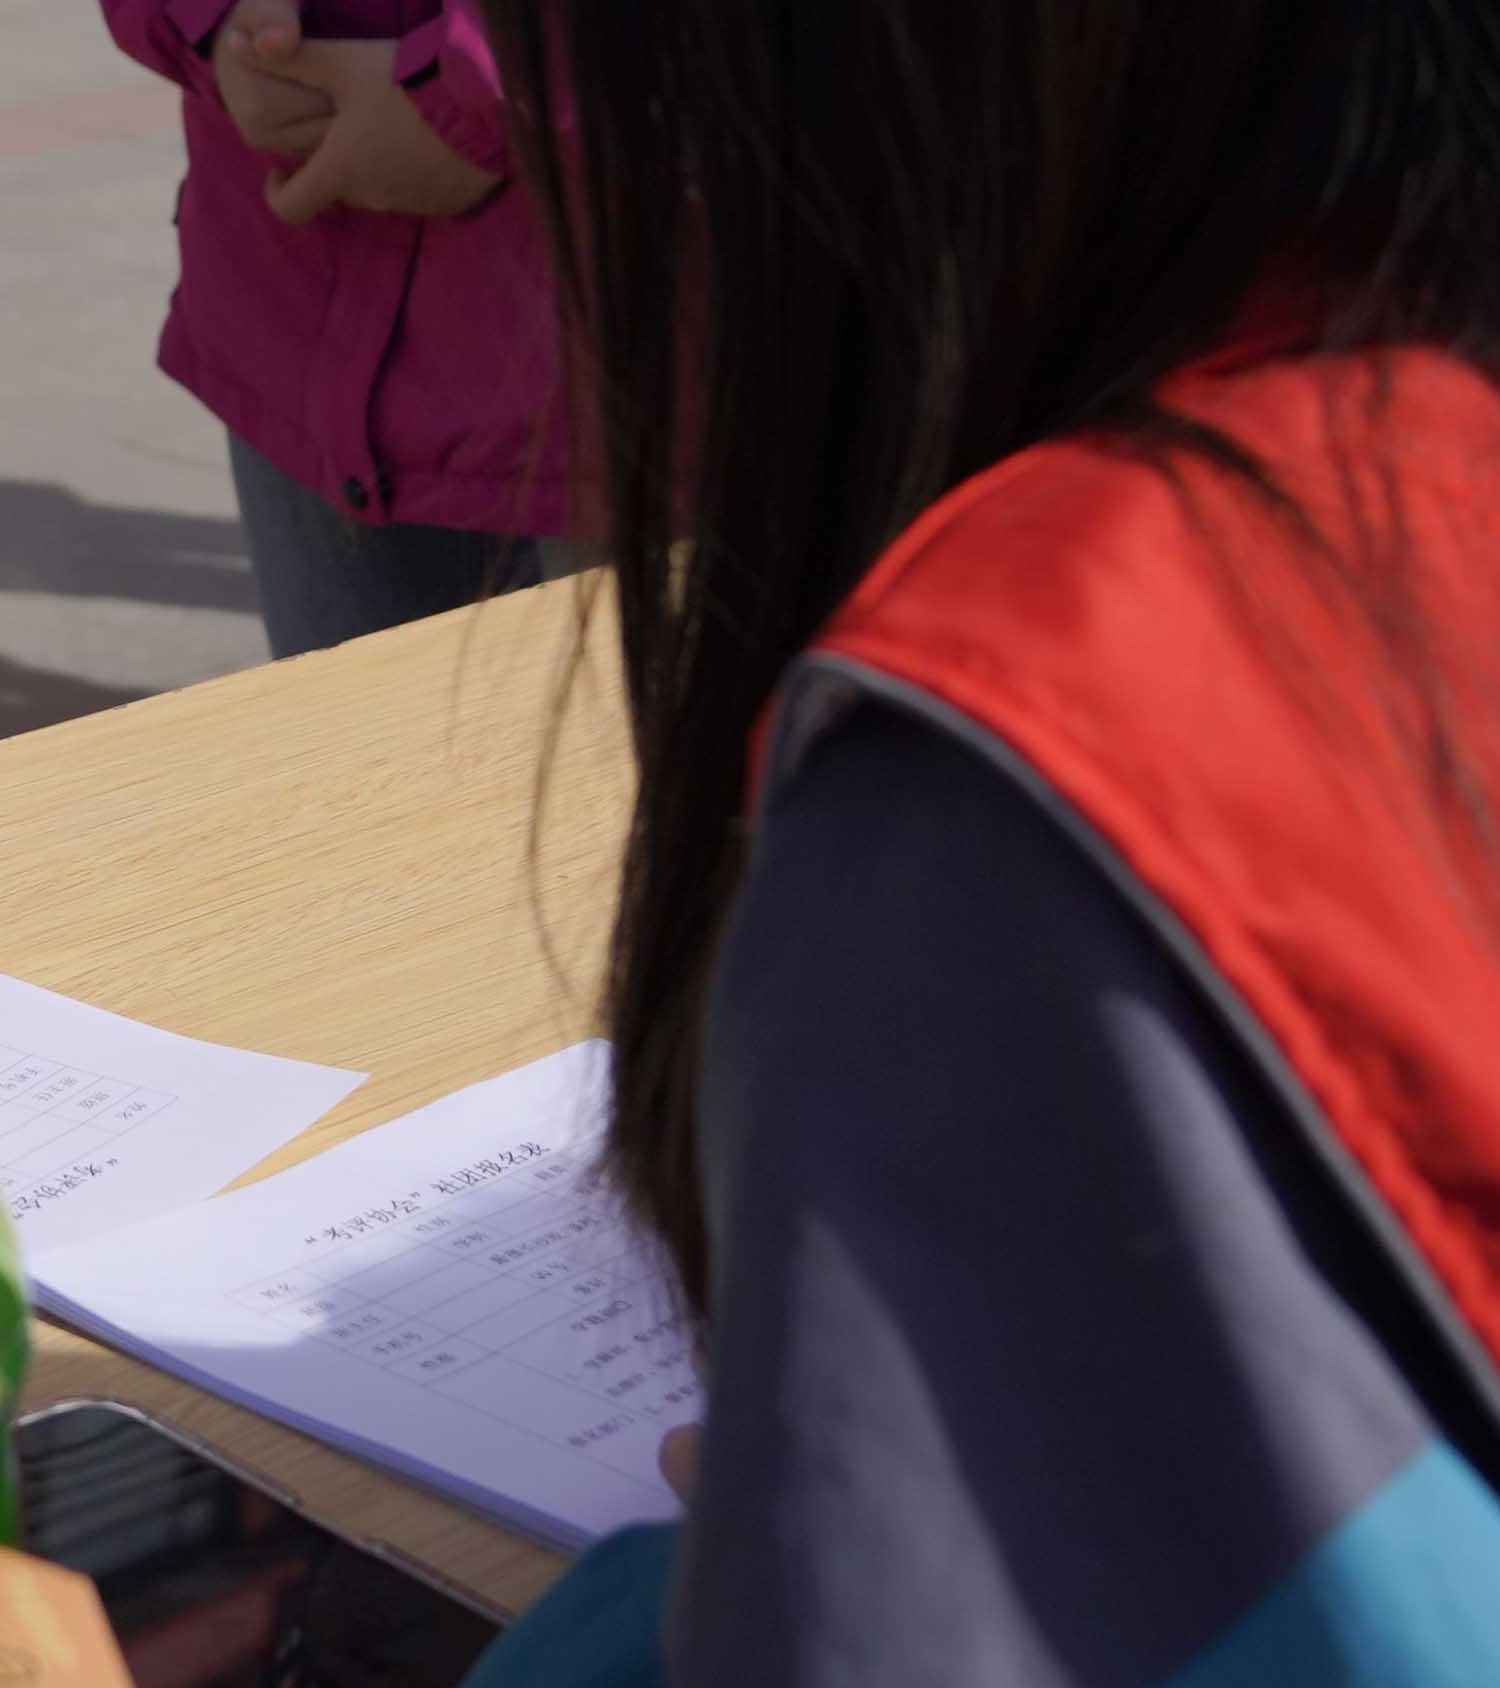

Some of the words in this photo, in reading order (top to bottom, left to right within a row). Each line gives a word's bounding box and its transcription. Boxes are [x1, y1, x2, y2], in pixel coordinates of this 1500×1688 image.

[434, 1141, 550, 1195] 社团报名表
